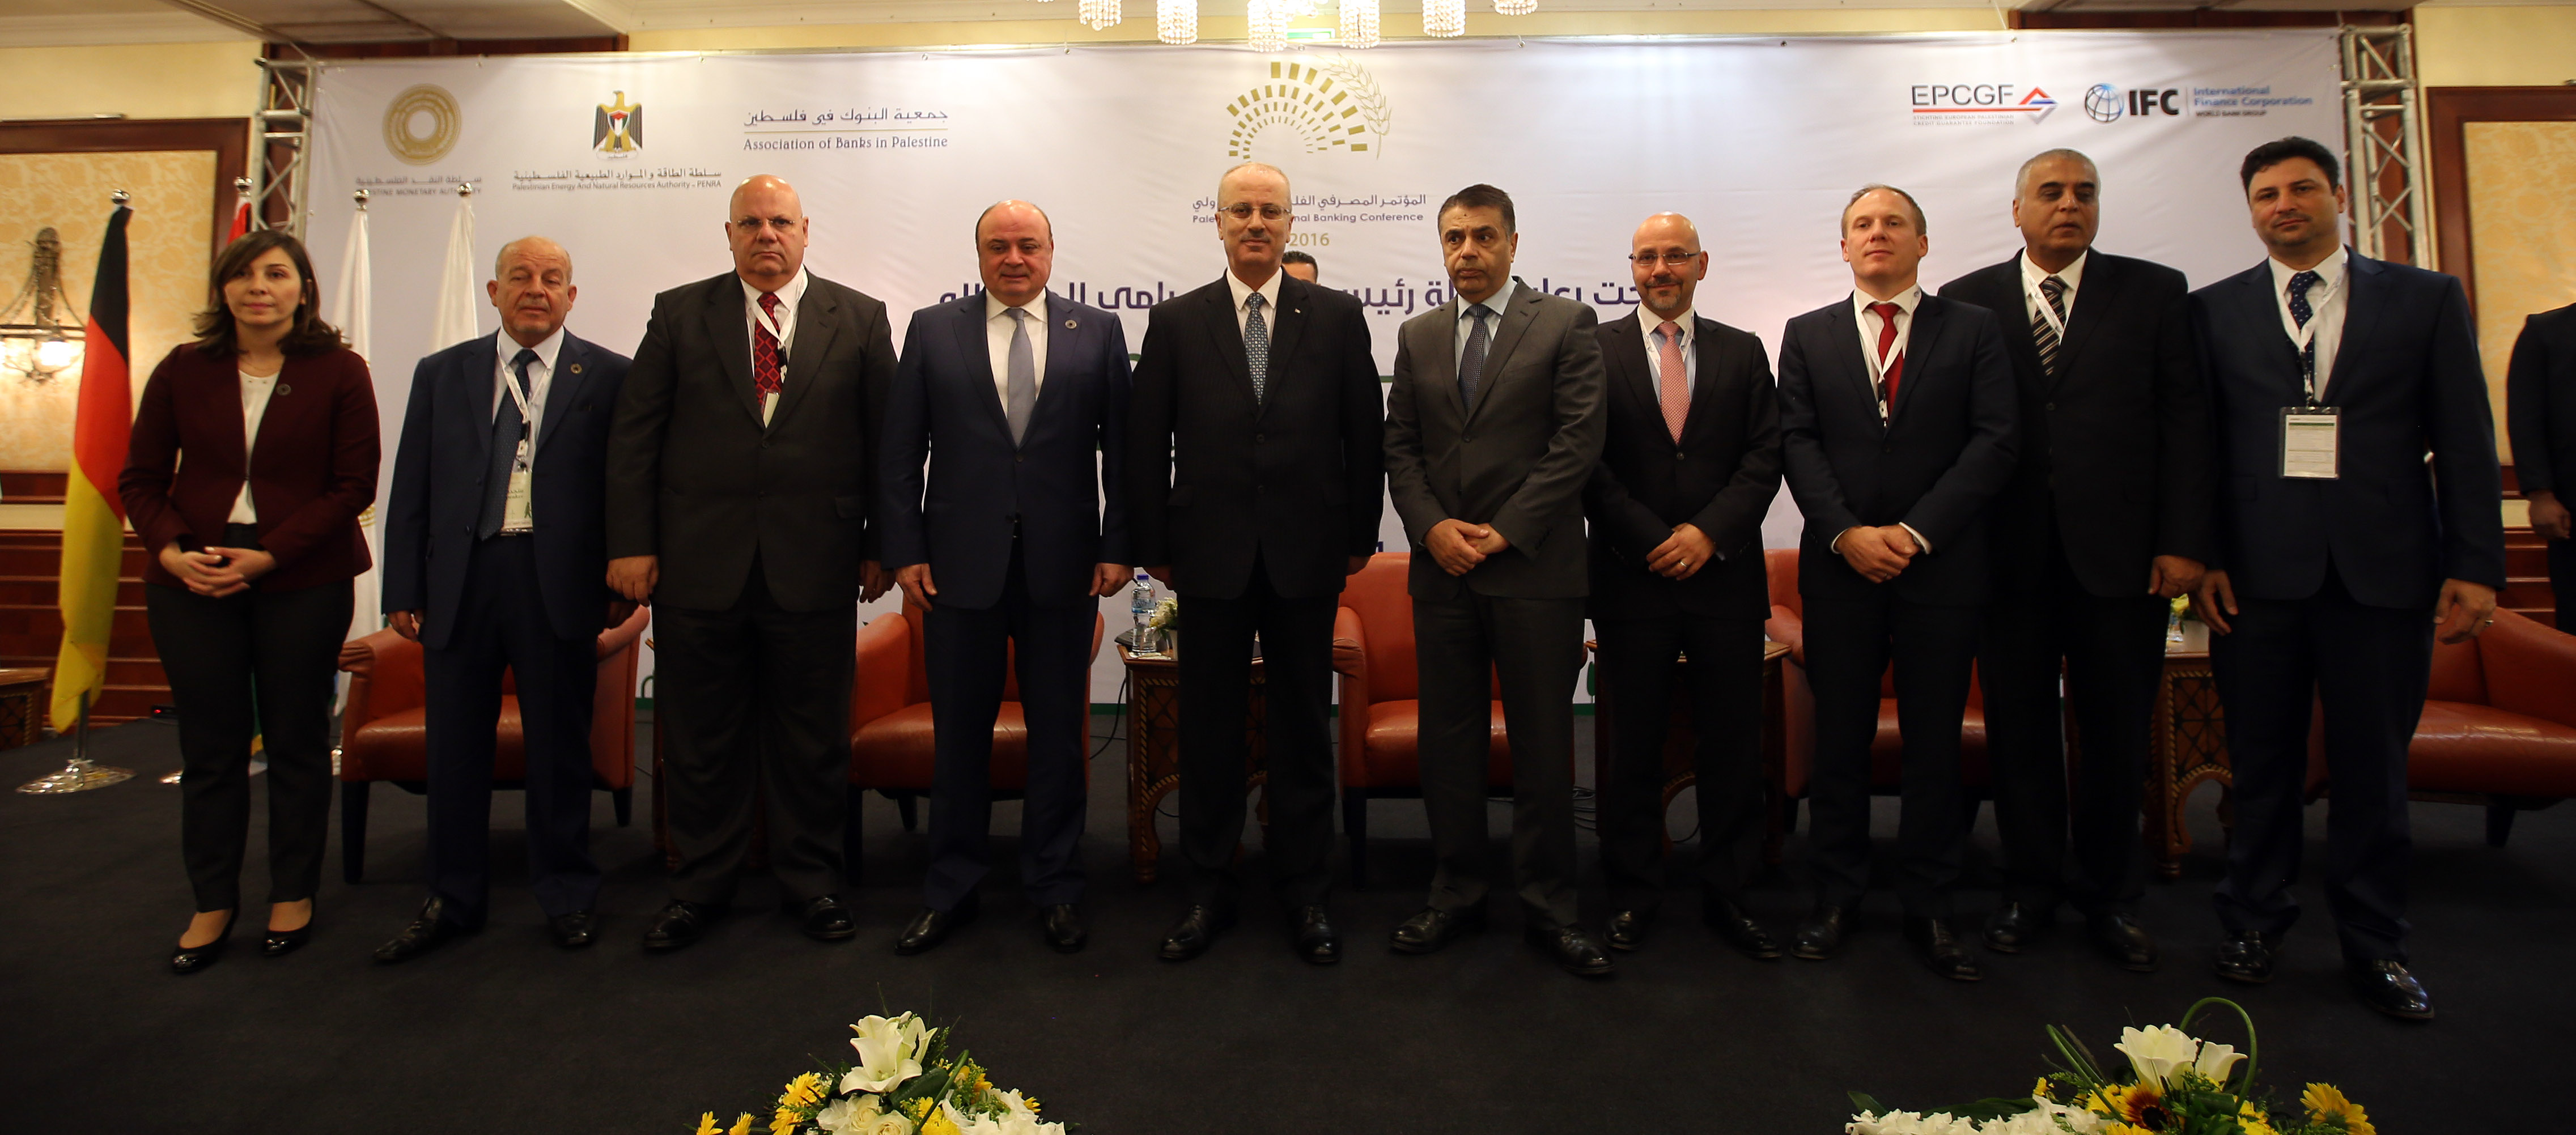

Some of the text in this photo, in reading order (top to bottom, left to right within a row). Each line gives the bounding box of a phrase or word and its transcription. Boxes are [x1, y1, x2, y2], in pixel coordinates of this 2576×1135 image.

[1912, 83, 2015, 106] EPCGF
[2193, 86, 2270, 95] International
[2129, 88, 2180, 116] IFC
[2241, 96, 2313, 107] Corporation
[744, 107, 948, 126] جمعية البنوك في فلسطين
[743, 136, 948, 150] Association of Banks in Palestine
[513, 171, 571, 181] الفلسطينية
[575, 169, 613, 181] الطبيعية
[616, 169, 647, 180] الموارد
[657, 168, 686, 178] الطاقة
[689, 167, 722, 178] سلطة
[512, 182, 550, 190] Palestinian
[551, 182, 576, 191] Energy
[657, 180, 690, 190] Authority
[1319, 194, 1377, 211] المصرفي
[1380, 194, 1427, 208] المؤتمر
[1314, 213, 1357, 224] Banking
[1360, 213, 1424, 222] Conference
[1289, 233, 1330, 246] 2016
